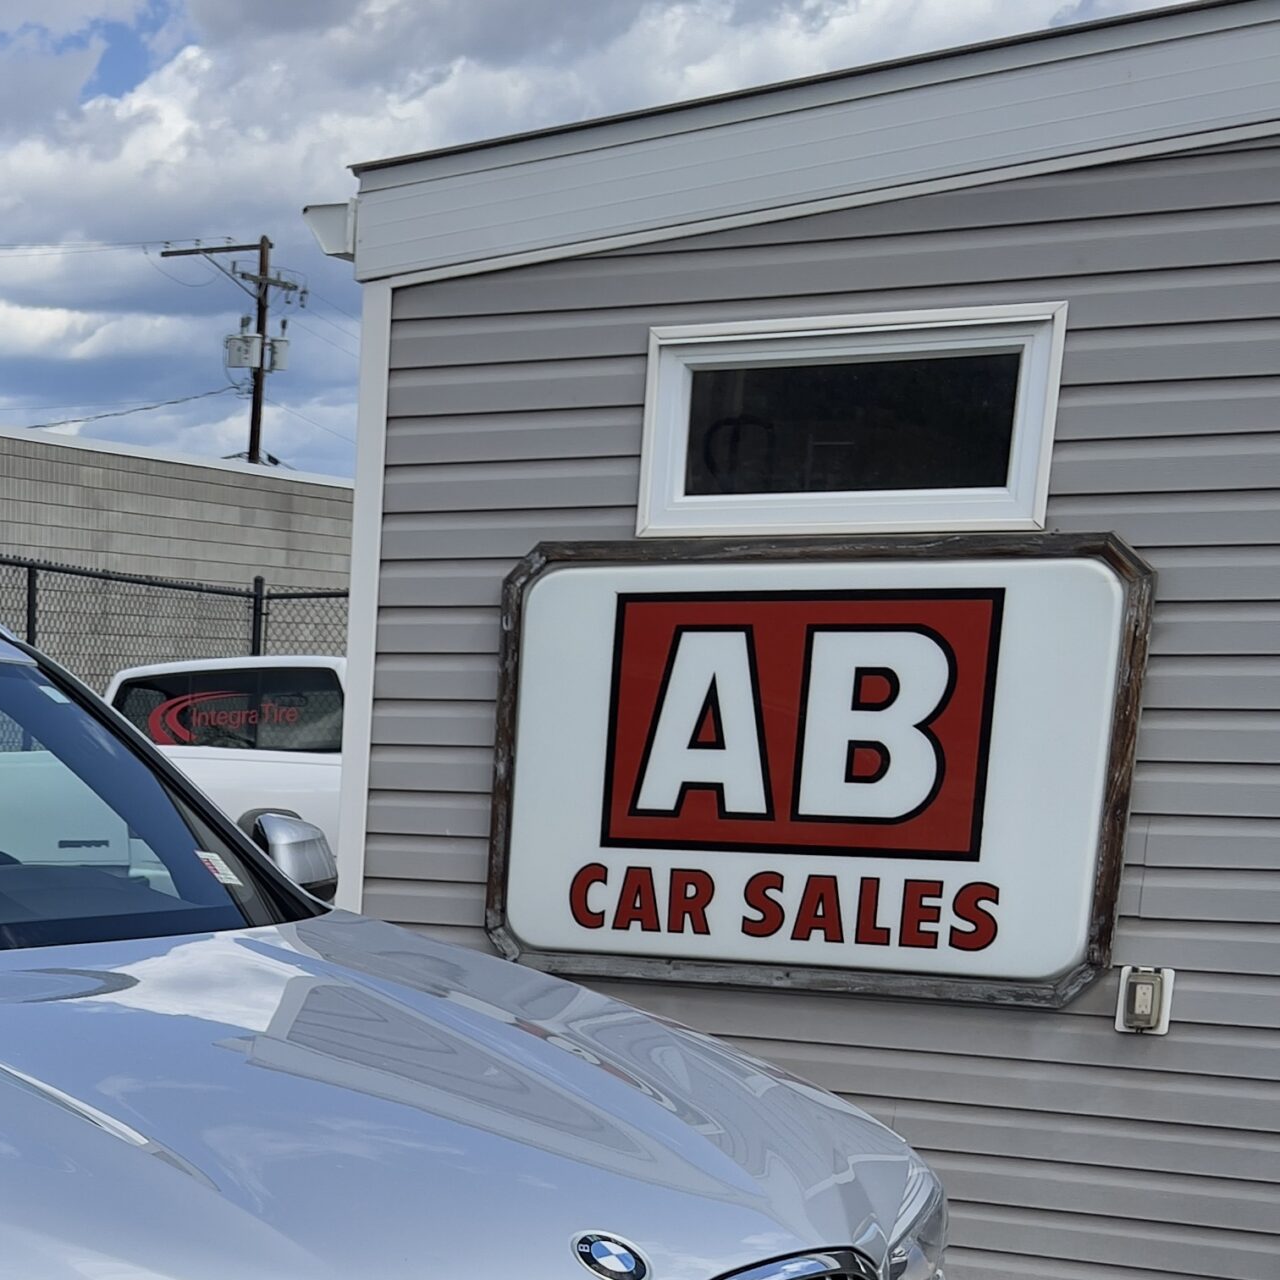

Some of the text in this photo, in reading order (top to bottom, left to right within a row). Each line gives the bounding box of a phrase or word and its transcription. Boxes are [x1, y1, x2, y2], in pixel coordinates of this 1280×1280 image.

[192, 703, 299, 729] Integra Tire
[628, 624, 958, 825] AB
[569, 863, 1000, 951] CAR SALES
